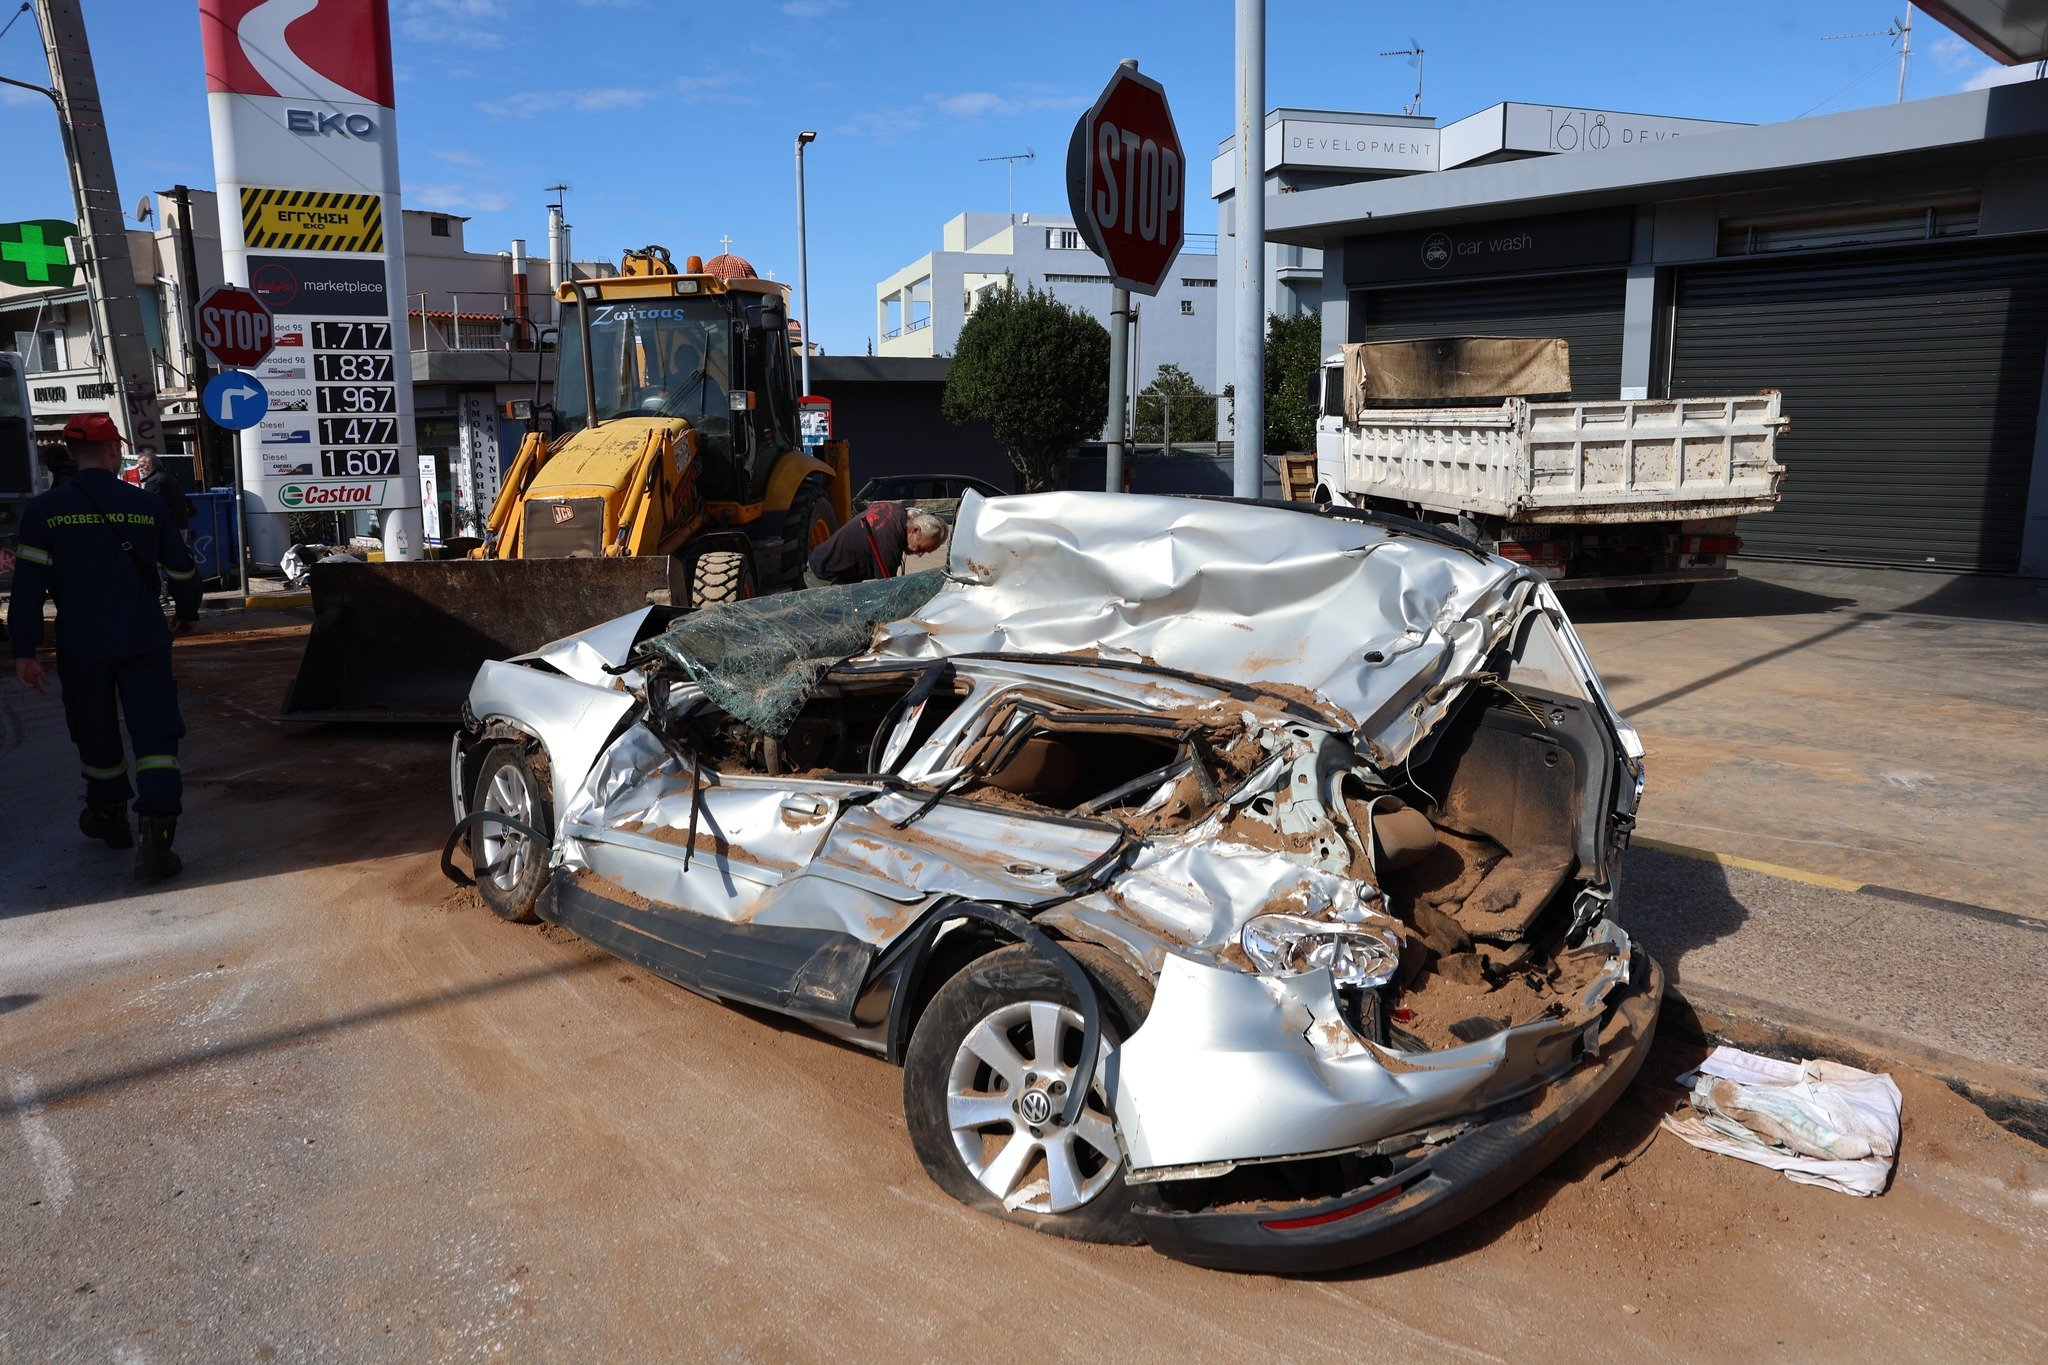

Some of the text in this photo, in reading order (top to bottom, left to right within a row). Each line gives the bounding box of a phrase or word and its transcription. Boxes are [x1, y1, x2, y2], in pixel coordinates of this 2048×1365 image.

[287, 109, 373, 136] EKO
[1293, 137, 1432, 155] DEVELOPMENT
[1097, 121, 1179, 246] STOP
[278, 210, 349, 224] ΕΓΓΥΗΣΗ
[1457, 233, 1532, 255] car wash
[304, 279, 383, 294] marketplace
[204, 307, 268, 351] STOP
[292, 323, 303, 331] 95
[316, 323, 388, 349] 1.717
[295, 356, 306, 364] 98
[319, 354, 391, 381] 1.837
[297, 388, 312, 397] 100
[321, 386, 393, 412] 1.967
[260, 421, 285, 429] Diesel
[323, 418, 394, 444] 1.477
[262, 453, 288, 461] Diesel
[325, 449, 397, 475] 1.607
[471, 399, 487, 531] ΟΜΟΙΟΠΑΘΗΙΚΑ
[486, 414, 497, 504] ΚΑΛΛΥΝΤΙΚ
[305, 484, 372, 504] Castrol
[46, 513, 155, 528] ΠΡΟΣΒΕΣΚΟ ΣΩΜΑ
[554, 507, 574, 522] JCB
